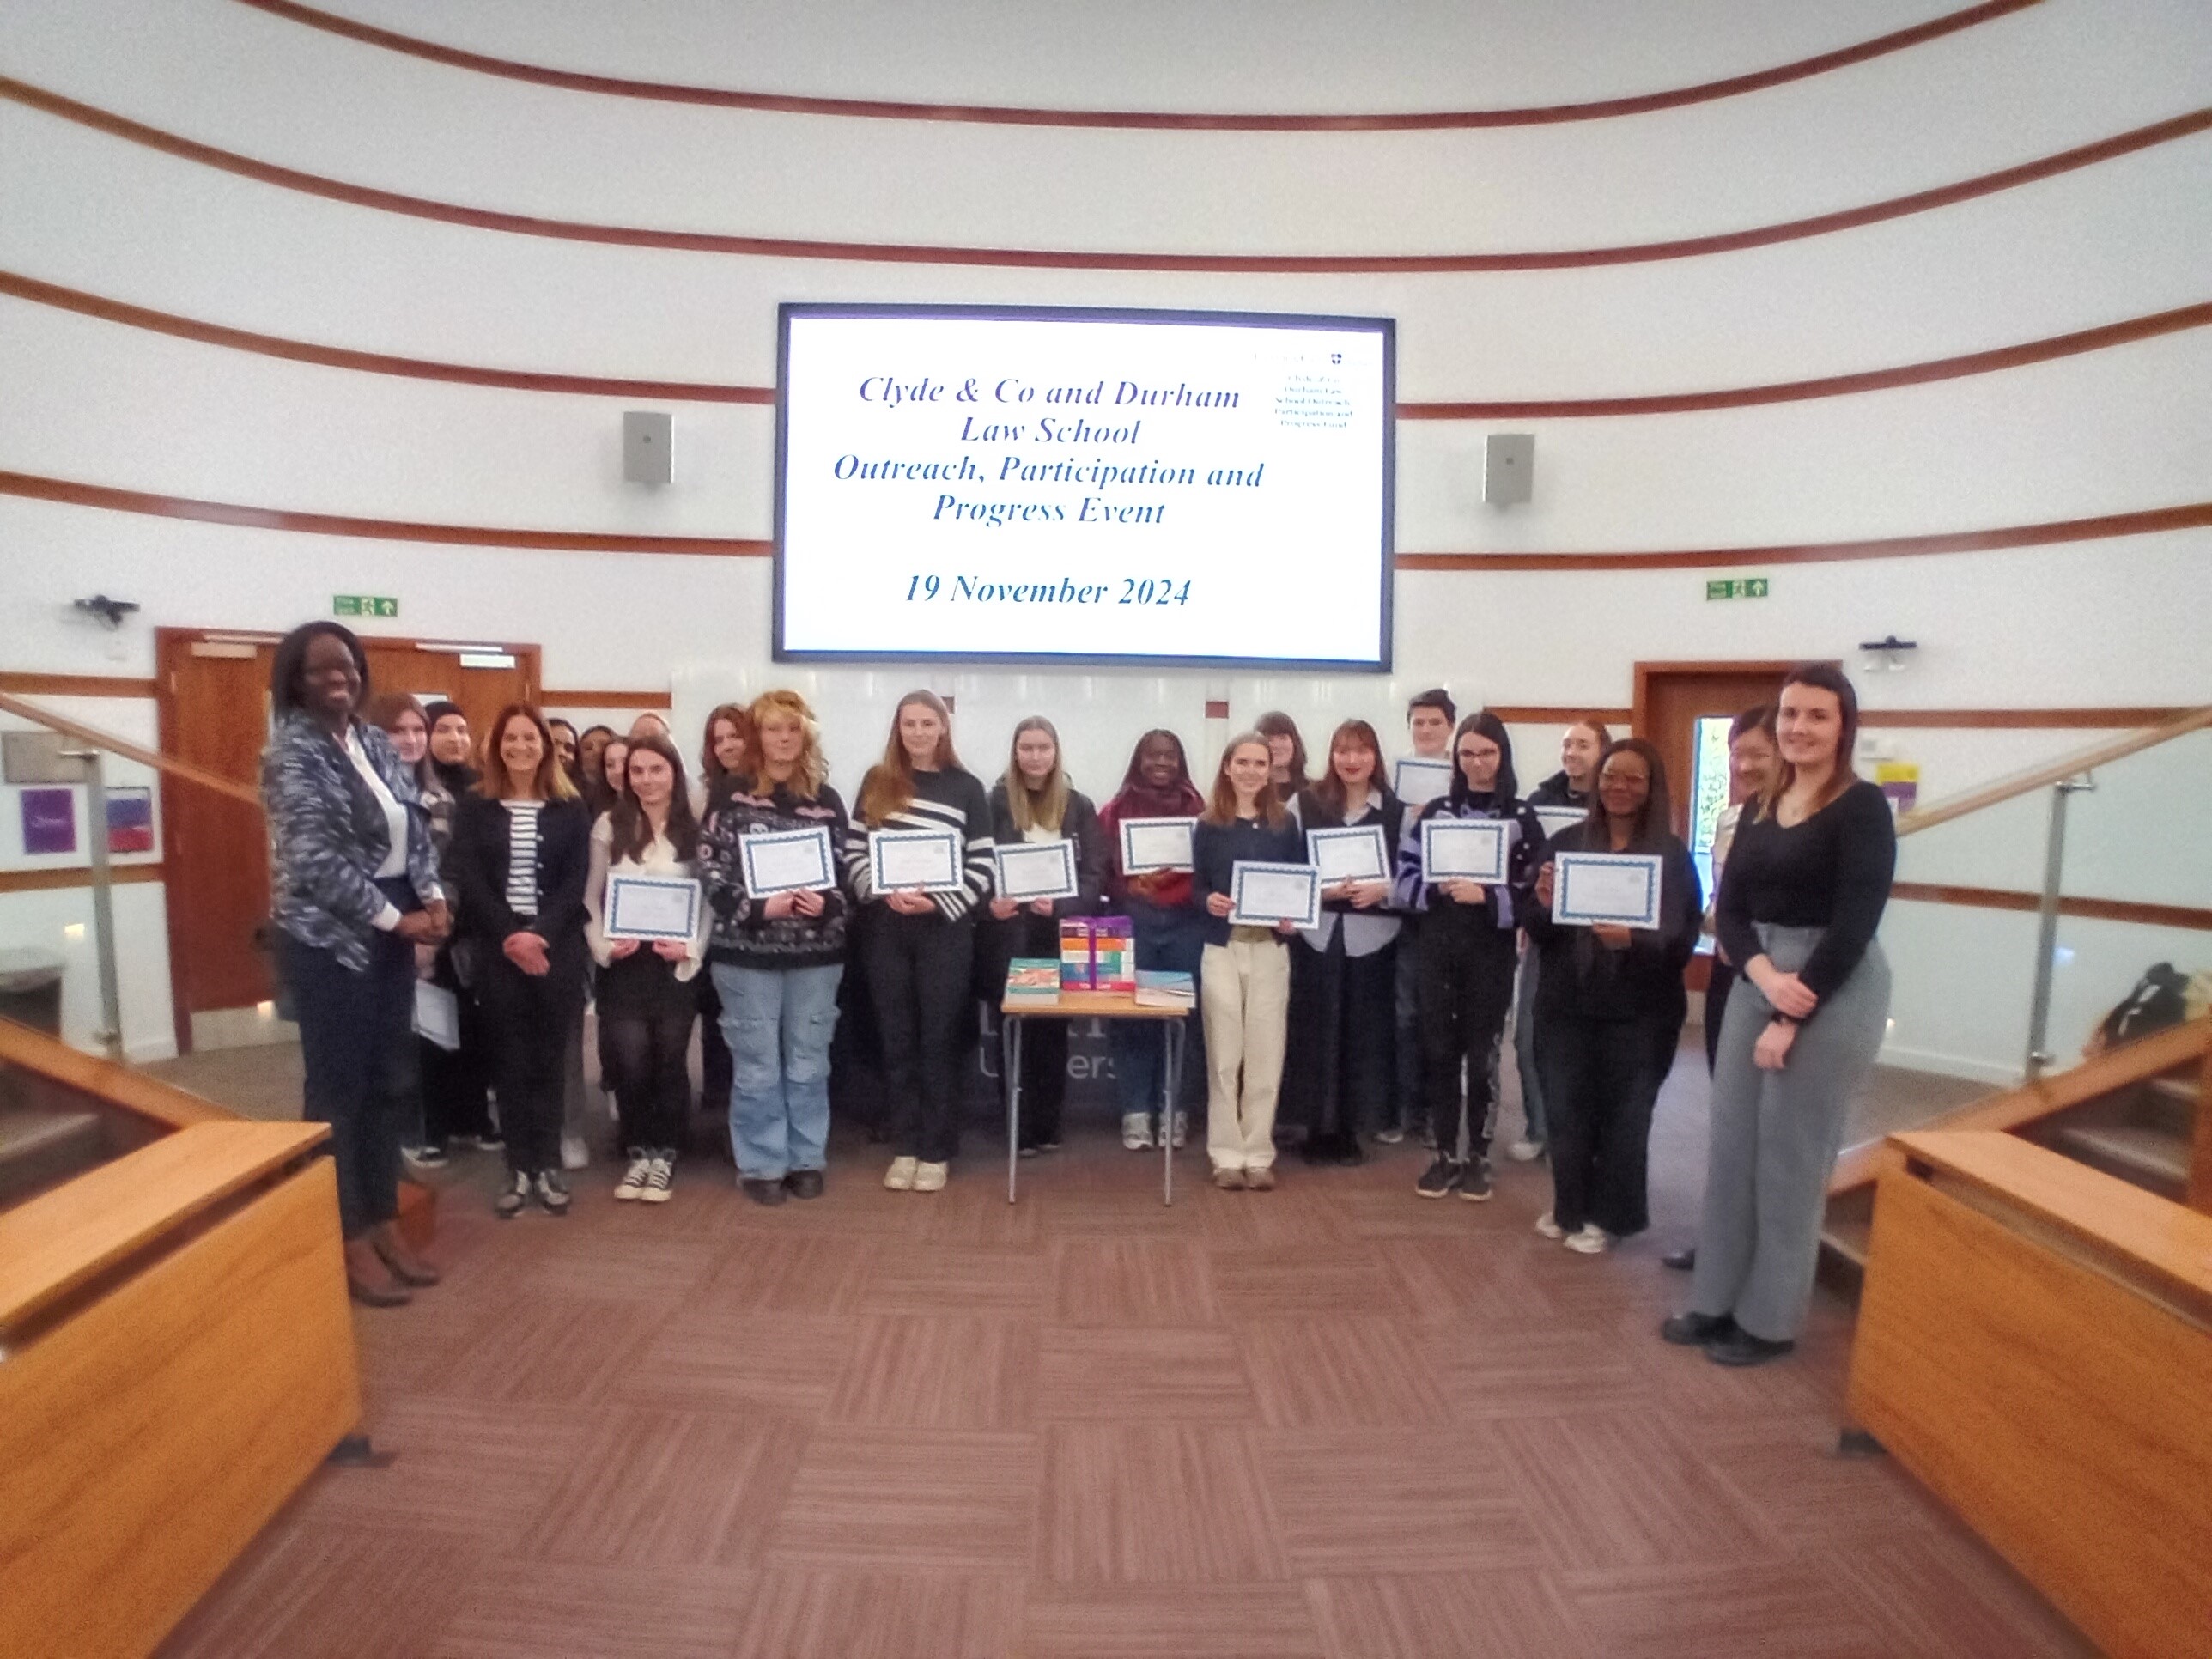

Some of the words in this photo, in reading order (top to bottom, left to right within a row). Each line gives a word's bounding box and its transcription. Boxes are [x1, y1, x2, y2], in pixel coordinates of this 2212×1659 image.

[860, 376, 945, 409] Clyde
[956, 377, 979, 403] &
[994, 378, 1035, 404] Co
[1045, 380, 1104, 405] and
[1114, 380, 1239, 409] Durham
[960, 416, 1025, 441] Law
[1034, 417, 1142, 445] School
[834, 454, 985, 483] Outreach,
[999, 456, 1195, 491] Participation
[1206, 462, 1265, 488] and
[933, 495, 1066, 528] Progress
[1078, 497, 1165, 525] Event
[906, 574, 940, 602] 19
[950, 575, 1109, 604] November
[1117, 578, 1192, 606] 2024
